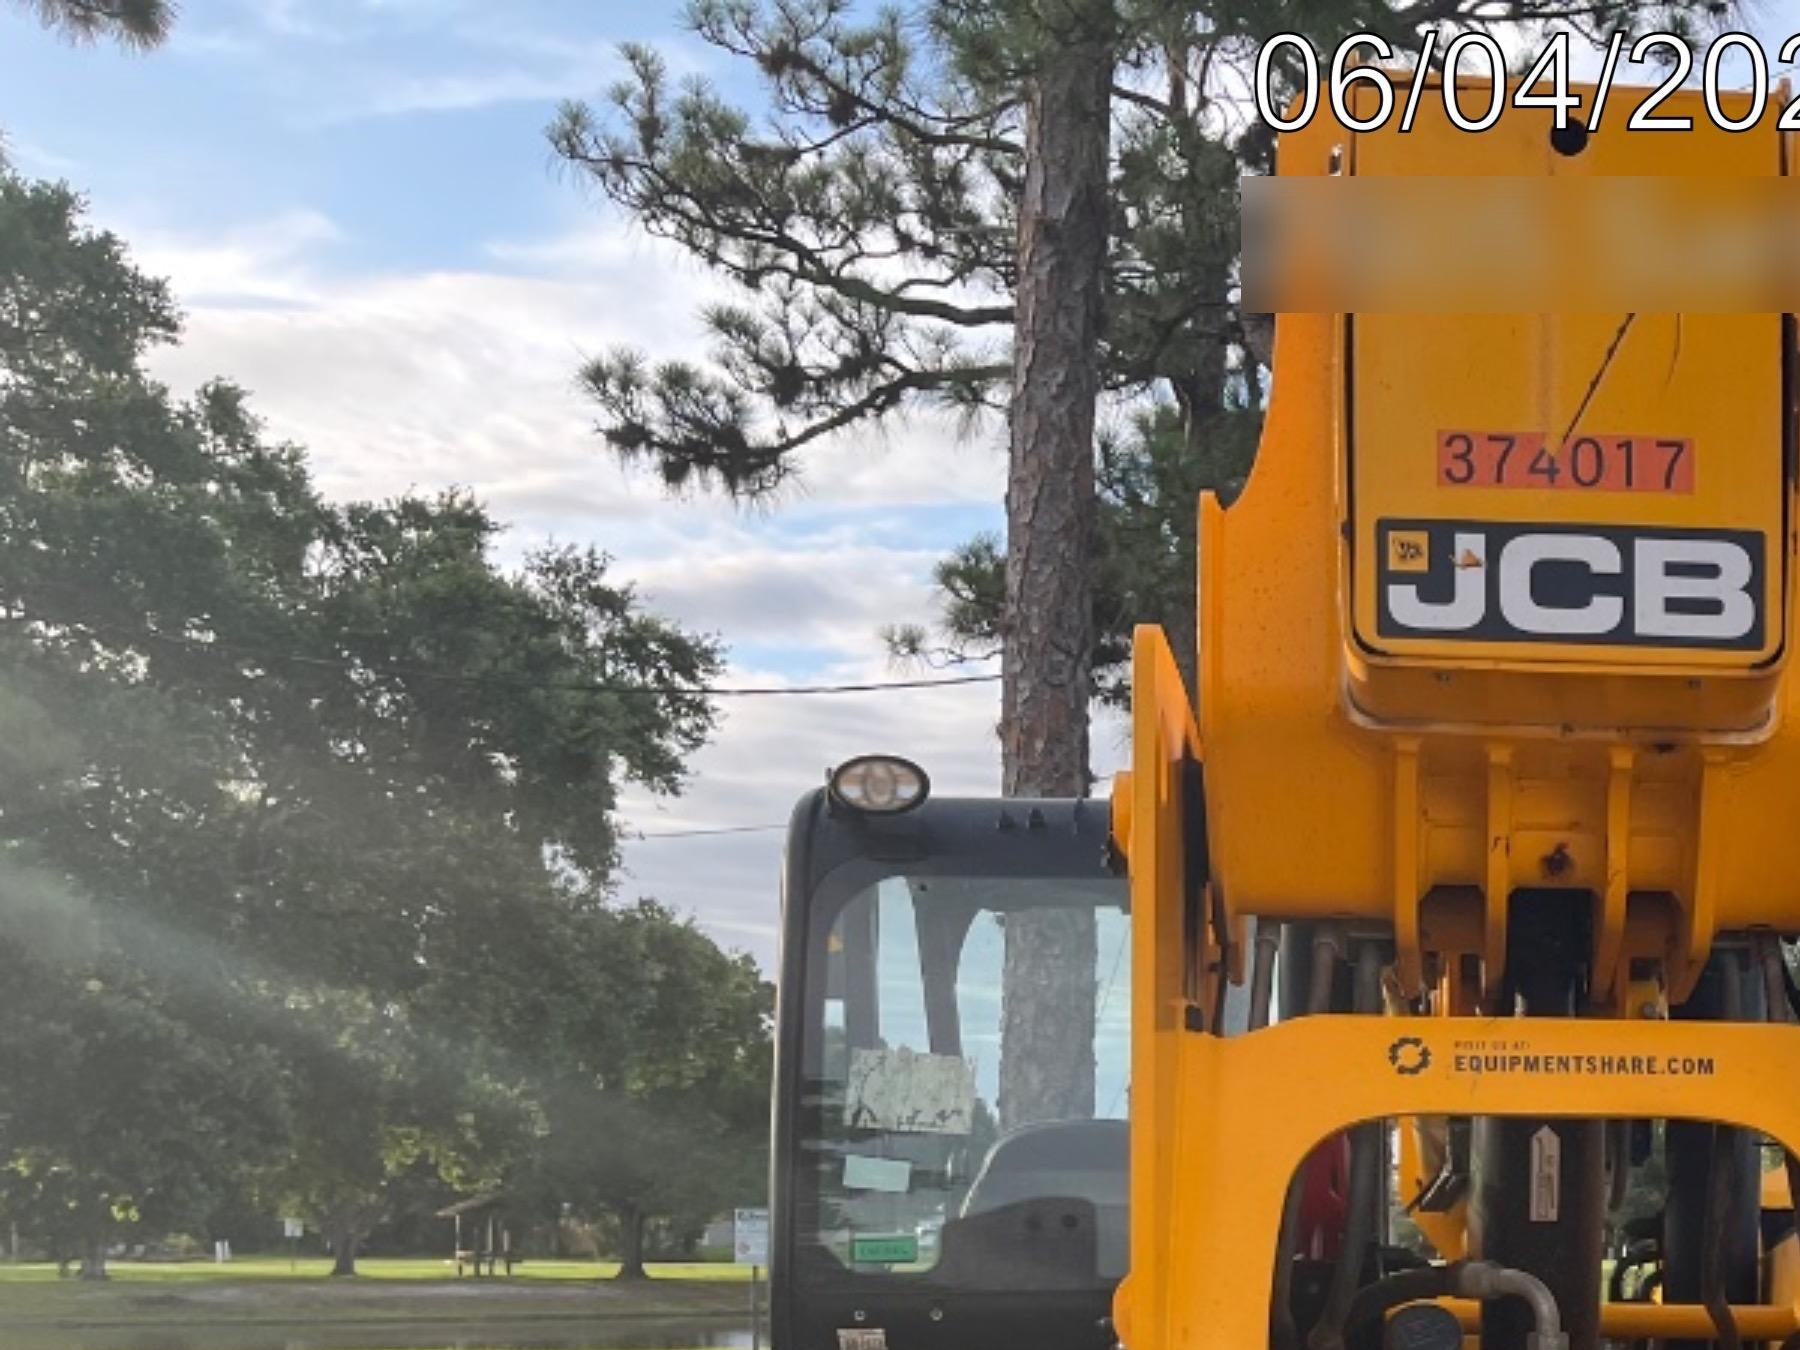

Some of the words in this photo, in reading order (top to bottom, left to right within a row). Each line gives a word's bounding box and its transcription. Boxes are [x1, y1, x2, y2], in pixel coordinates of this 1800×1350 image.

[1443, 433, 1685, 490] 374017
[1388, 533, 1755, 639] JCB
[1454, 1055, 1715, 1075] EQUIPMENTSHARE.COM
